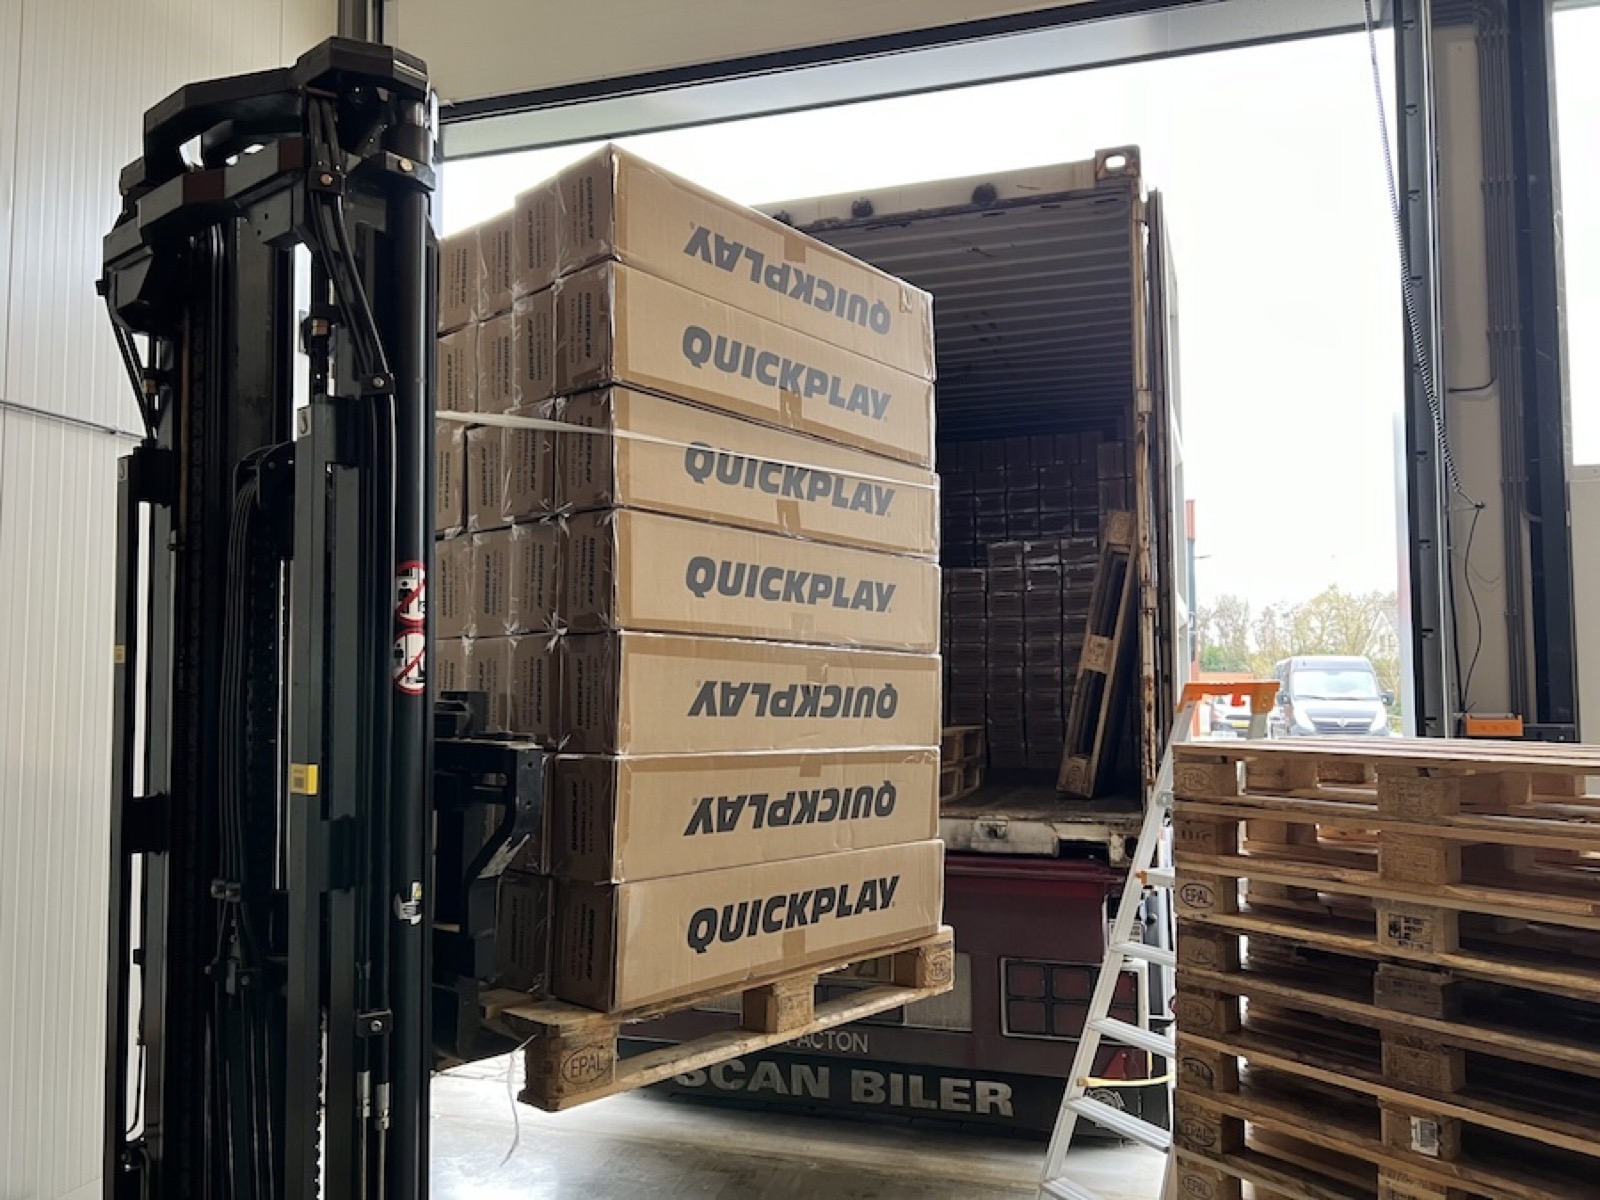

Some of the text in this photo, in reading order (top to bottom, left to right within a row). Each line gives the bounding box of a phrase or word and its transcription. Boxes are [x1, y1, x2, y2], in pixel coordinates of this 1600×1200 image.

[683, 225, 891, 336] QUICKPLAY
[682, 324, 892, 421] QUICKPLAY
[684, 441, 896, 517] QUICKPLAY
[686, 556, 898, 613] QUICKPLAY
[686, 680, 900, 719] QUICKPLAY
[683, 780, 898, 838] QUICKPLAY
[687, 875, 901, 955] QUICKPLAY
[1185, 888, 1208, 904] EPAL
[569, 1053, 604, 1078] EPAL
[786, 1031, 869, 1054] ACTON
[851, 1069, 1014, 1117] BILER
